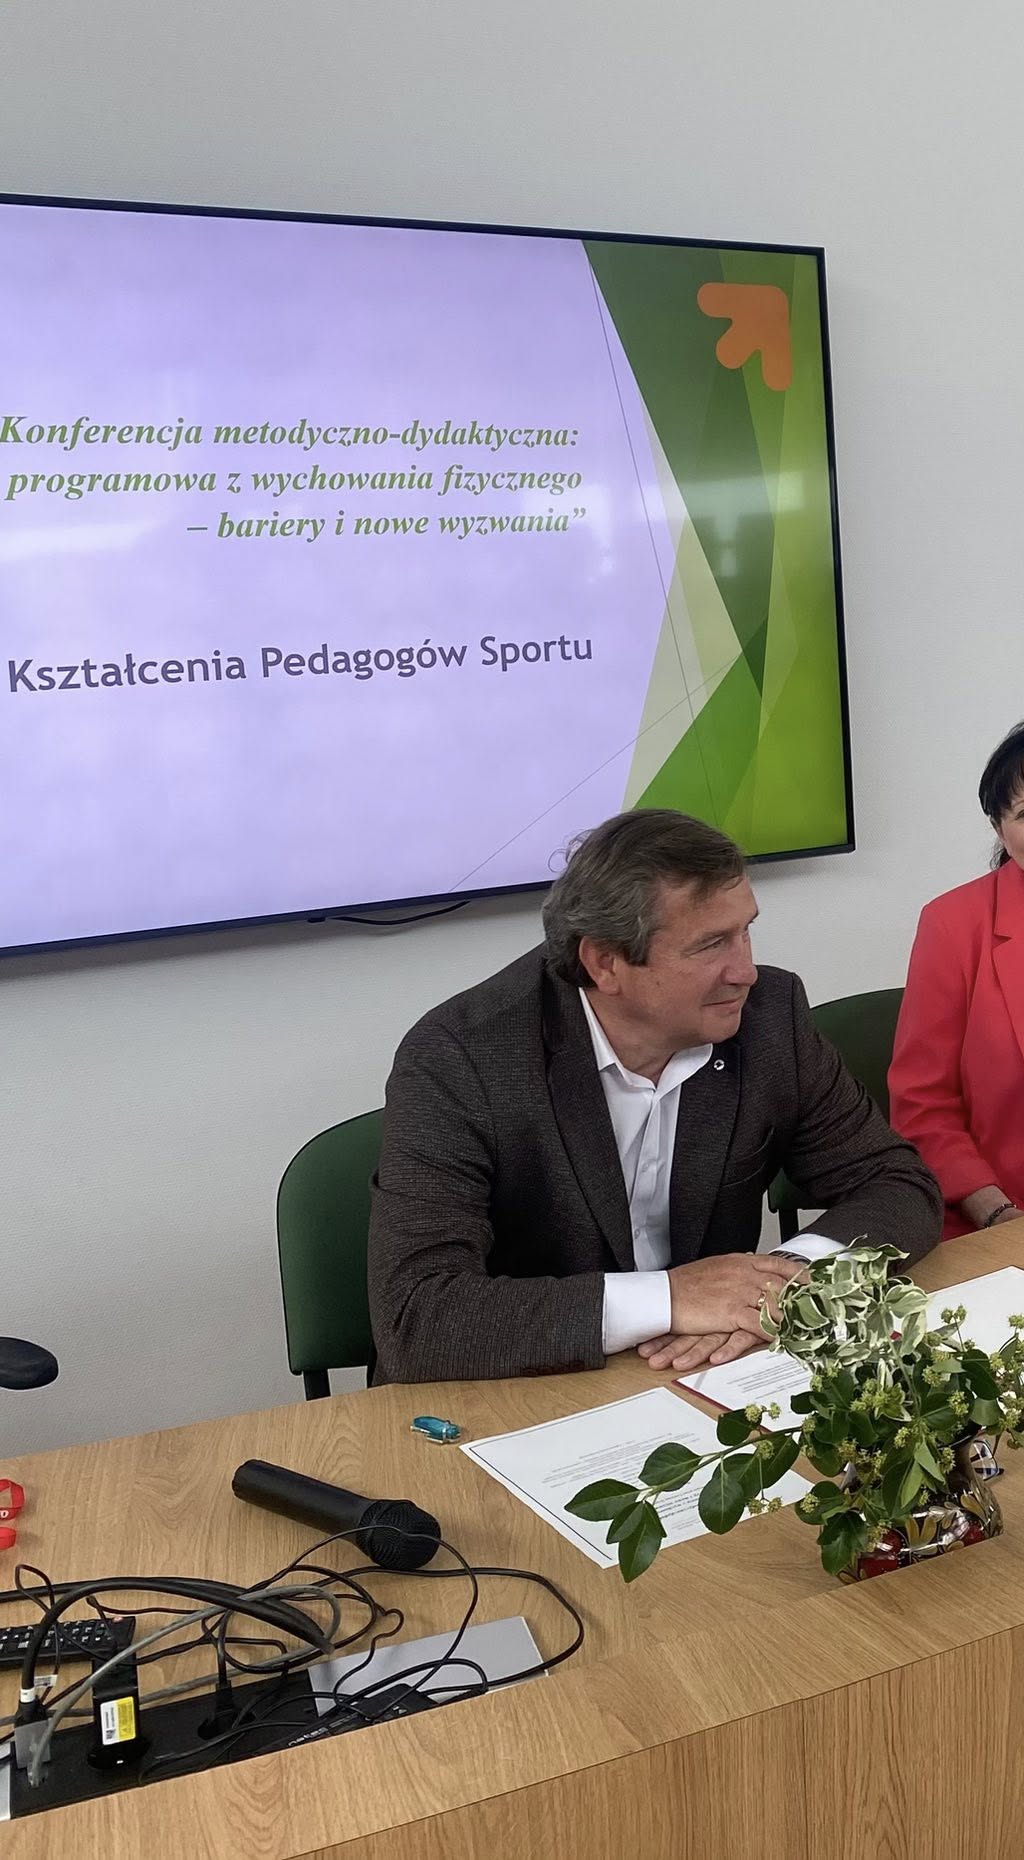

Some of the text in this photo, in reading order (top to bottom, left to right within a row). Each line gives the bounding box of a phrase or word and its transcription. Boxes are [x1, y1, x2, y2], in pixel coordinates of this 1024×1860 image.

[0, 416, 579, 453] Konferencja metodyczno-dydaktyczna:
[4, 465, 582, 501] programowa z wychowania fizycznego
[217, 511, 326, 543] bariery
[334, 509, 345, 536] i
[353, 516, 430, 535] nowe
[437, 506, 586, 541] wyzwania”
[8, 635, 593, 693] Kształcenia Pedagogów Sportu
